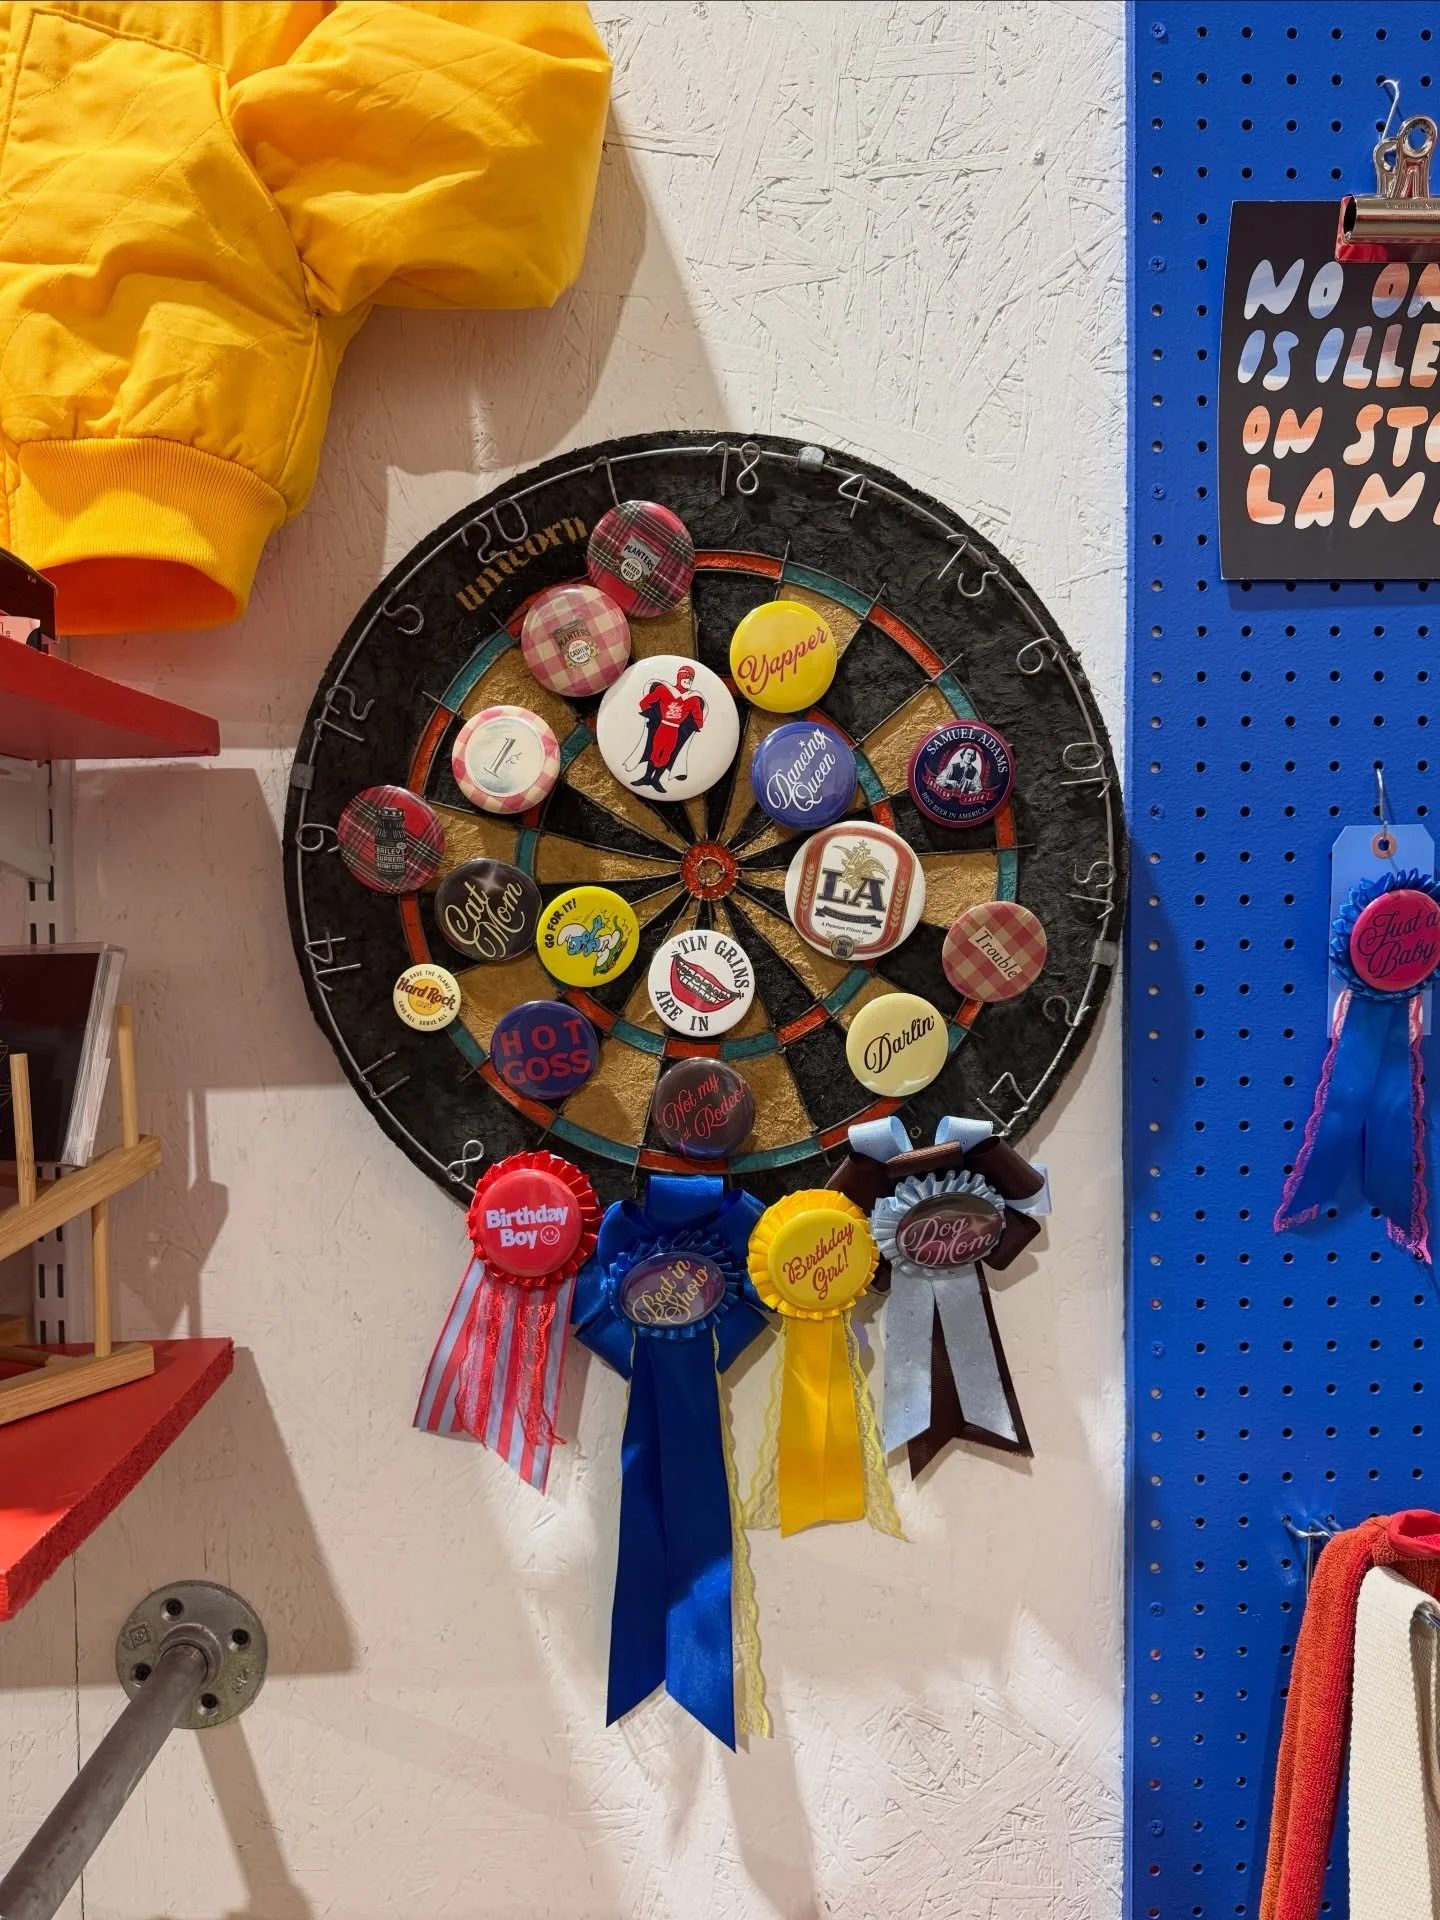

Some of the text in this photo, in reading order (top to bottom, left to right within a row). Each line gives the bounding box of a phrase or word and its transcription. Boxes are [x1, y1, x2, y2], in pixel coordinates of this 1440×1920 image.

[1243, 258, 1344, 320] NO
[1237, 323, 1440, 391] IS ILLE
[1243, 405, 1323, 459] ON
[707, 442, 762, 496] 18
[838, 474, 869, 519] 4
[1247, 464, 1440, 528] LAN
[461, 500, 528, 564] 20
[623, 545, 655, 571] PLANTERS
[455, 516, 588, 612] unicorn
[622, 567, 636, 580] NUTS
[624, 561, 641, 576] MIXED
[737, 626, 828, 695] Yapper
[313, 684, 376, 742] 12
[766, 728, 833, 810] Dancing
[926, 728, 1008, 773] SAMUEL ADAMS
[792, 752, 836, 812] Queen
[921, 792, 934, 806] BEST
[932, 804, 947, 816] BEER
[958, 806, 988, 819] AMERICA
[445, 880, 489, 945] Cat
[816, 866, 886, 912] LA
[474, 882, 526, 958] Mom
[544, 897, 577, 949] GO FOR IT!
[1357, 909, 1440, 957] Just a
[677, 935, 750, 991] TIN GRINS
[975, 930, 1018, 978] Trouble
[1367, 938, 1437, 978] Baby
[396, 976, 456, 1011] Hard Rock
[409, 970, 423, 980] SAVE
[437, 974, 453, 993] PLANET
[398, 1000, 407, 1014] LOVE
[406, 1013, 415, 1023] ALL
[438, 1013, 448, 1023] ALL
[500, 1017, 583, 1057] HOT
[655, 989, 709, 1032] ARE IN
[503, 1048, 592, 1086] GOSS
[864, 1015, 935, 1073] Darlin'
[662, 1072, 720, 1131] Not my
[694, 1078, 746, 1139] Rodeo!
[485, 1203, 569, 1229] Birthday
[500, 1228, 538, 1250] Boy
[901, 1215, 969, 1252] Dog
[782, 1222, 854, 1284] Birthday
[812, 1246, 849, 1300] Girl!
[914, 1231, 999, 1266] Mom
[632, 1260, 691, 1324] Best in
[664, 1264, 709, 1324] Show
